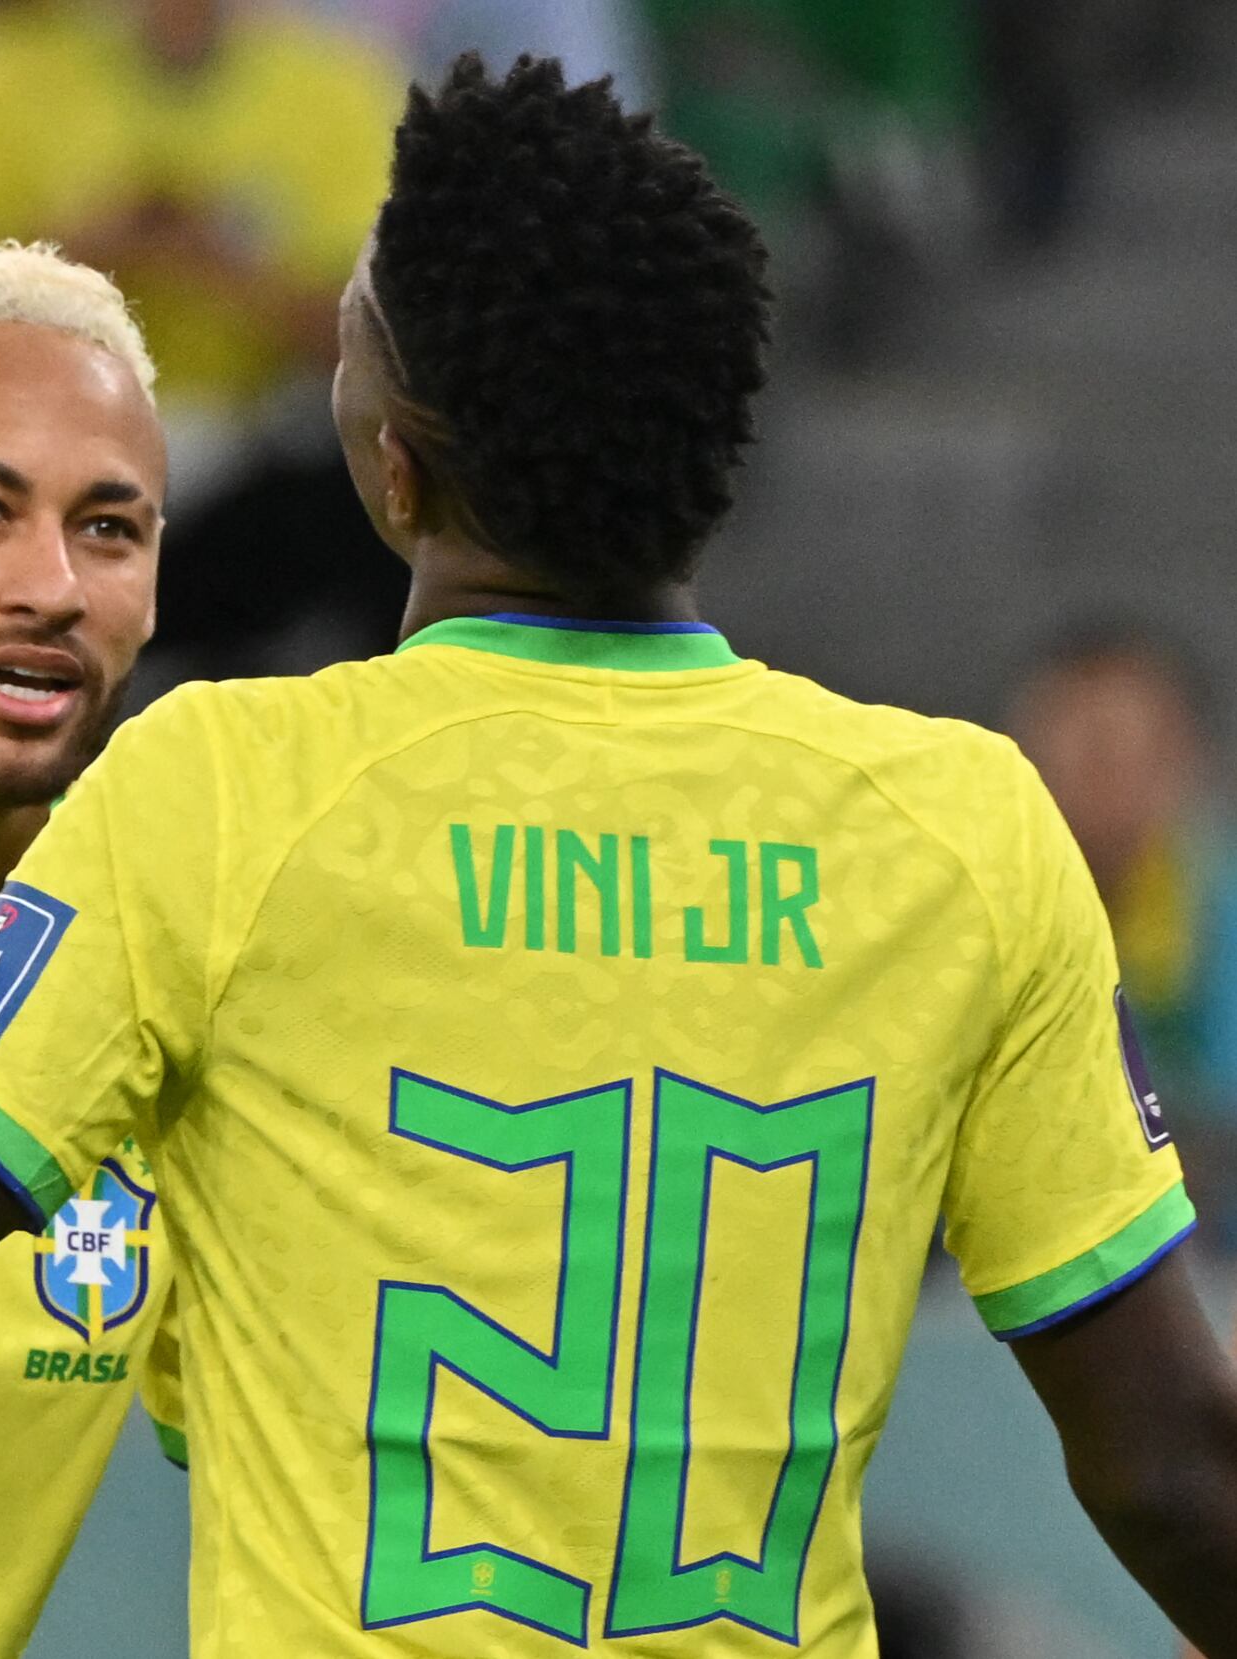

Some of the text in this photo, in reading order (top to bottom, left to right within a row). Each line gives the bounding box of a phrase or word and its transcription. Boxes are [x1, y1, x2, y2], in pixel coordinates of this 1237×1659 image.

[449, 823, 825, 969] VINI JR
[66, 1230, 112, 1253] CBF
[361, 1065, 877, 1649] 20
